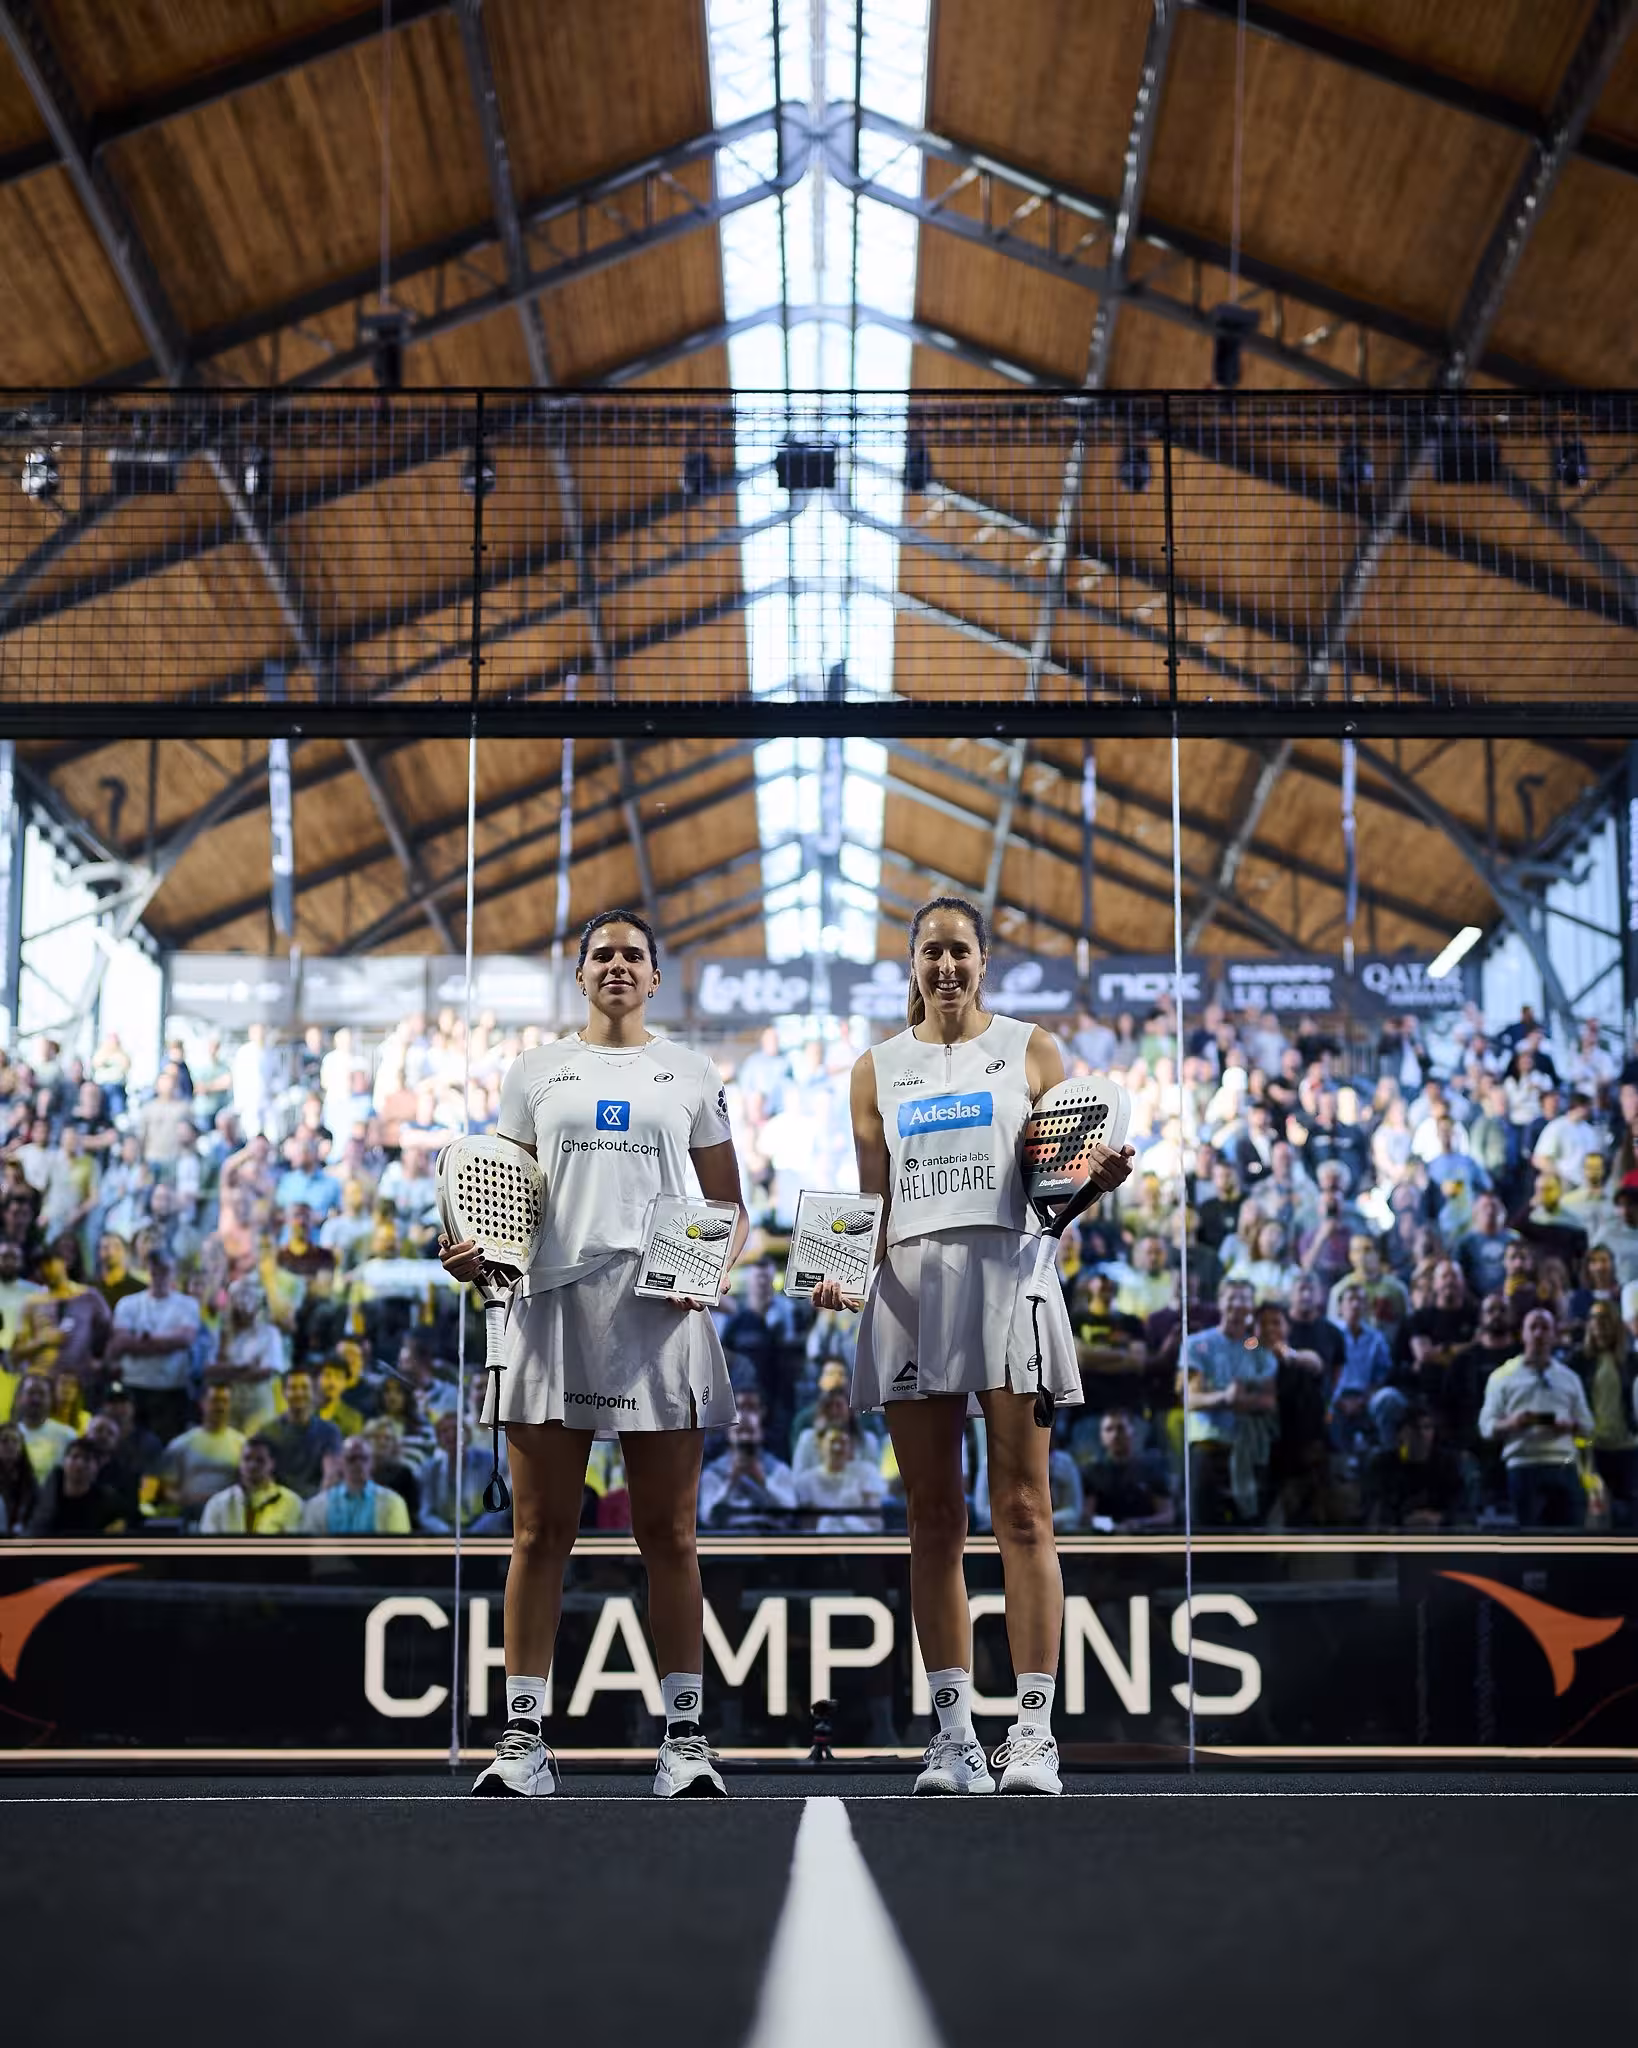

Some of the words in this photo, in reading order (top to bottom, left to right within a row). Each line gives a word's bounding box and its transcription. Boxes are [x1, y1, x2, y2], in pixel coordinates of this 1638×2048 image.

[549, 1075, 581, 1083] PADEL
[893, 1079, 925, 1087] PADEL
[909, 1101, 981, 1126] Adeslas
[561, 1139, 660, 1157] Checkout.com
[922, 1154, 967, 1167] cantabria
[969, 1152, 989, 1161] labs
[900, 1166, 996, 1203] HELIOCARE
